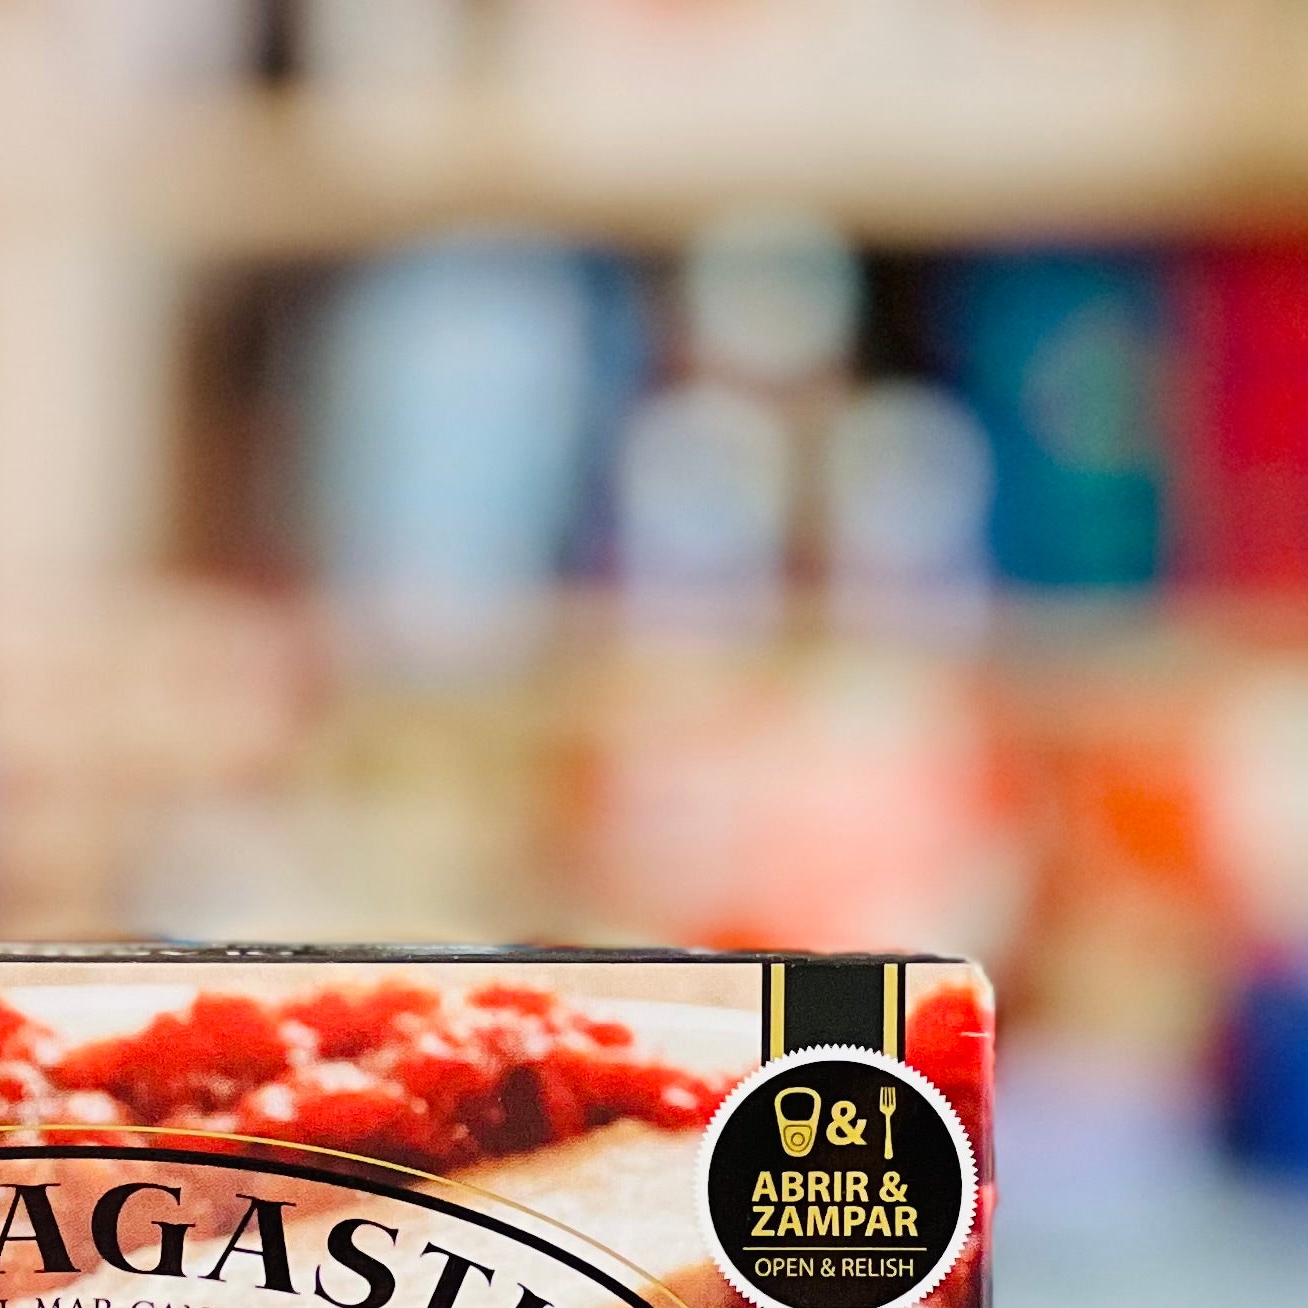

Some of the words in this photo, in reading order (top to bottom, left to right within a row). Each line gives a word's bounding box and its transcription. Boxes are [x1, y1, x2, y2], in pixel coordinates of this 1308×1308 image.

[752, 1171, 869, 1202] ABRIR
[879, 1171, 908, 1202] &
[751, 1205, 919, 1237] ZAMPAR
[754, 1257, 814, 1277] OPEN
[820, 1257, 836, 1277] &
[842, 1257, 914, 1277] RELISH
